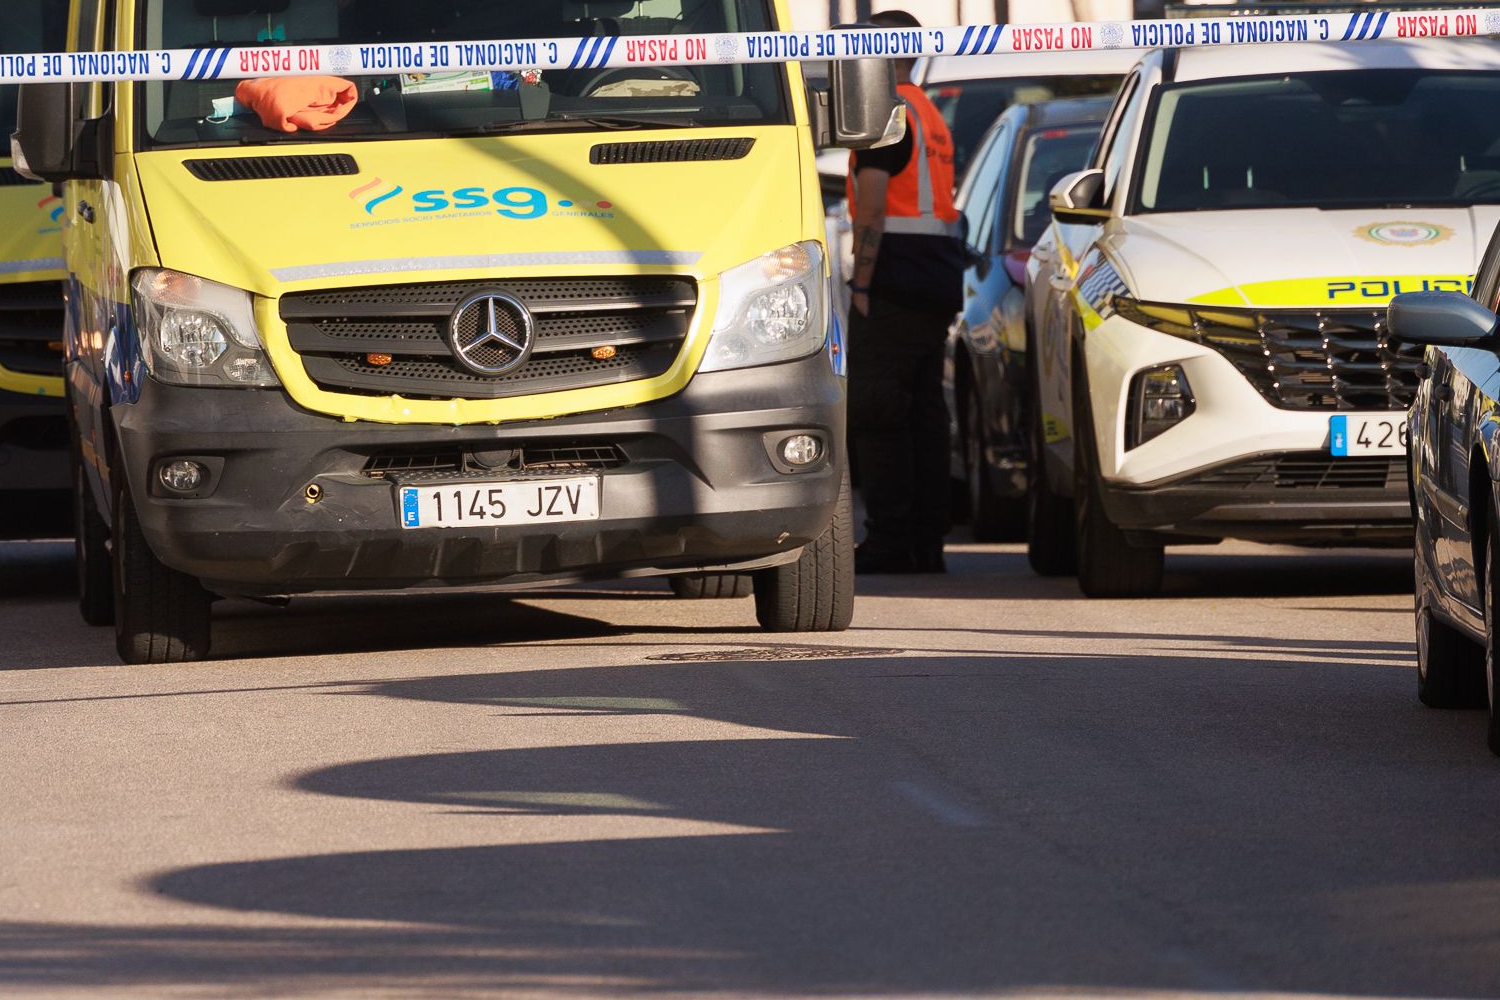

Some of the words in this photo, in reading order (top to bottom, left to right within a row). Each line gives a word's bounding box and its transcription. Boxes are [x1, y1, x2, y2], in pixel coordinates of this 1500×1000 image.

[1131, 23, 1195, 46] POLICIA
[1201, 22, 1221, 44] DE
[1226, 20, 1308, 43] NACIONAL
[1314, 18, 1329, 40] C.
[1396, 15, 1449, 39] PASAR
[1456, 14, 1478, 37] NO
[685, 38, 707, 61] NO
[746, 35, 810, 58] POLICIA
[816, 34, 836, 57] DE
[841, 32, 923, 56] NACIONAL
[928, 31, 944, 53] C.
[1011, 28, 1064, 52] PASAR
[1071, 26, 1093, 50] NO
[239, 49, 292, 72] PASAR
[299, 48, 320, 70] NO
[359, 47, 424, 69] POLICIA
[430, 45, 449, 67] DE
[455, 43, 537, 66] NACIONAL
[543, 42, 558, 64] C.
[626, 39, 679, 63] PASAR
[42, 55, 62, 77] DE
[69, 53, 150, 76] NACIONAL
[156, 52, 171, 74] C.
[411, 186, 548, 219] ssg
[1327, 275, 1474, 299] POLICÍ
[407, 511, 416, 521] E
[432, 489, 507, 522] 1145
[526, 484, 582, 517] JZV
